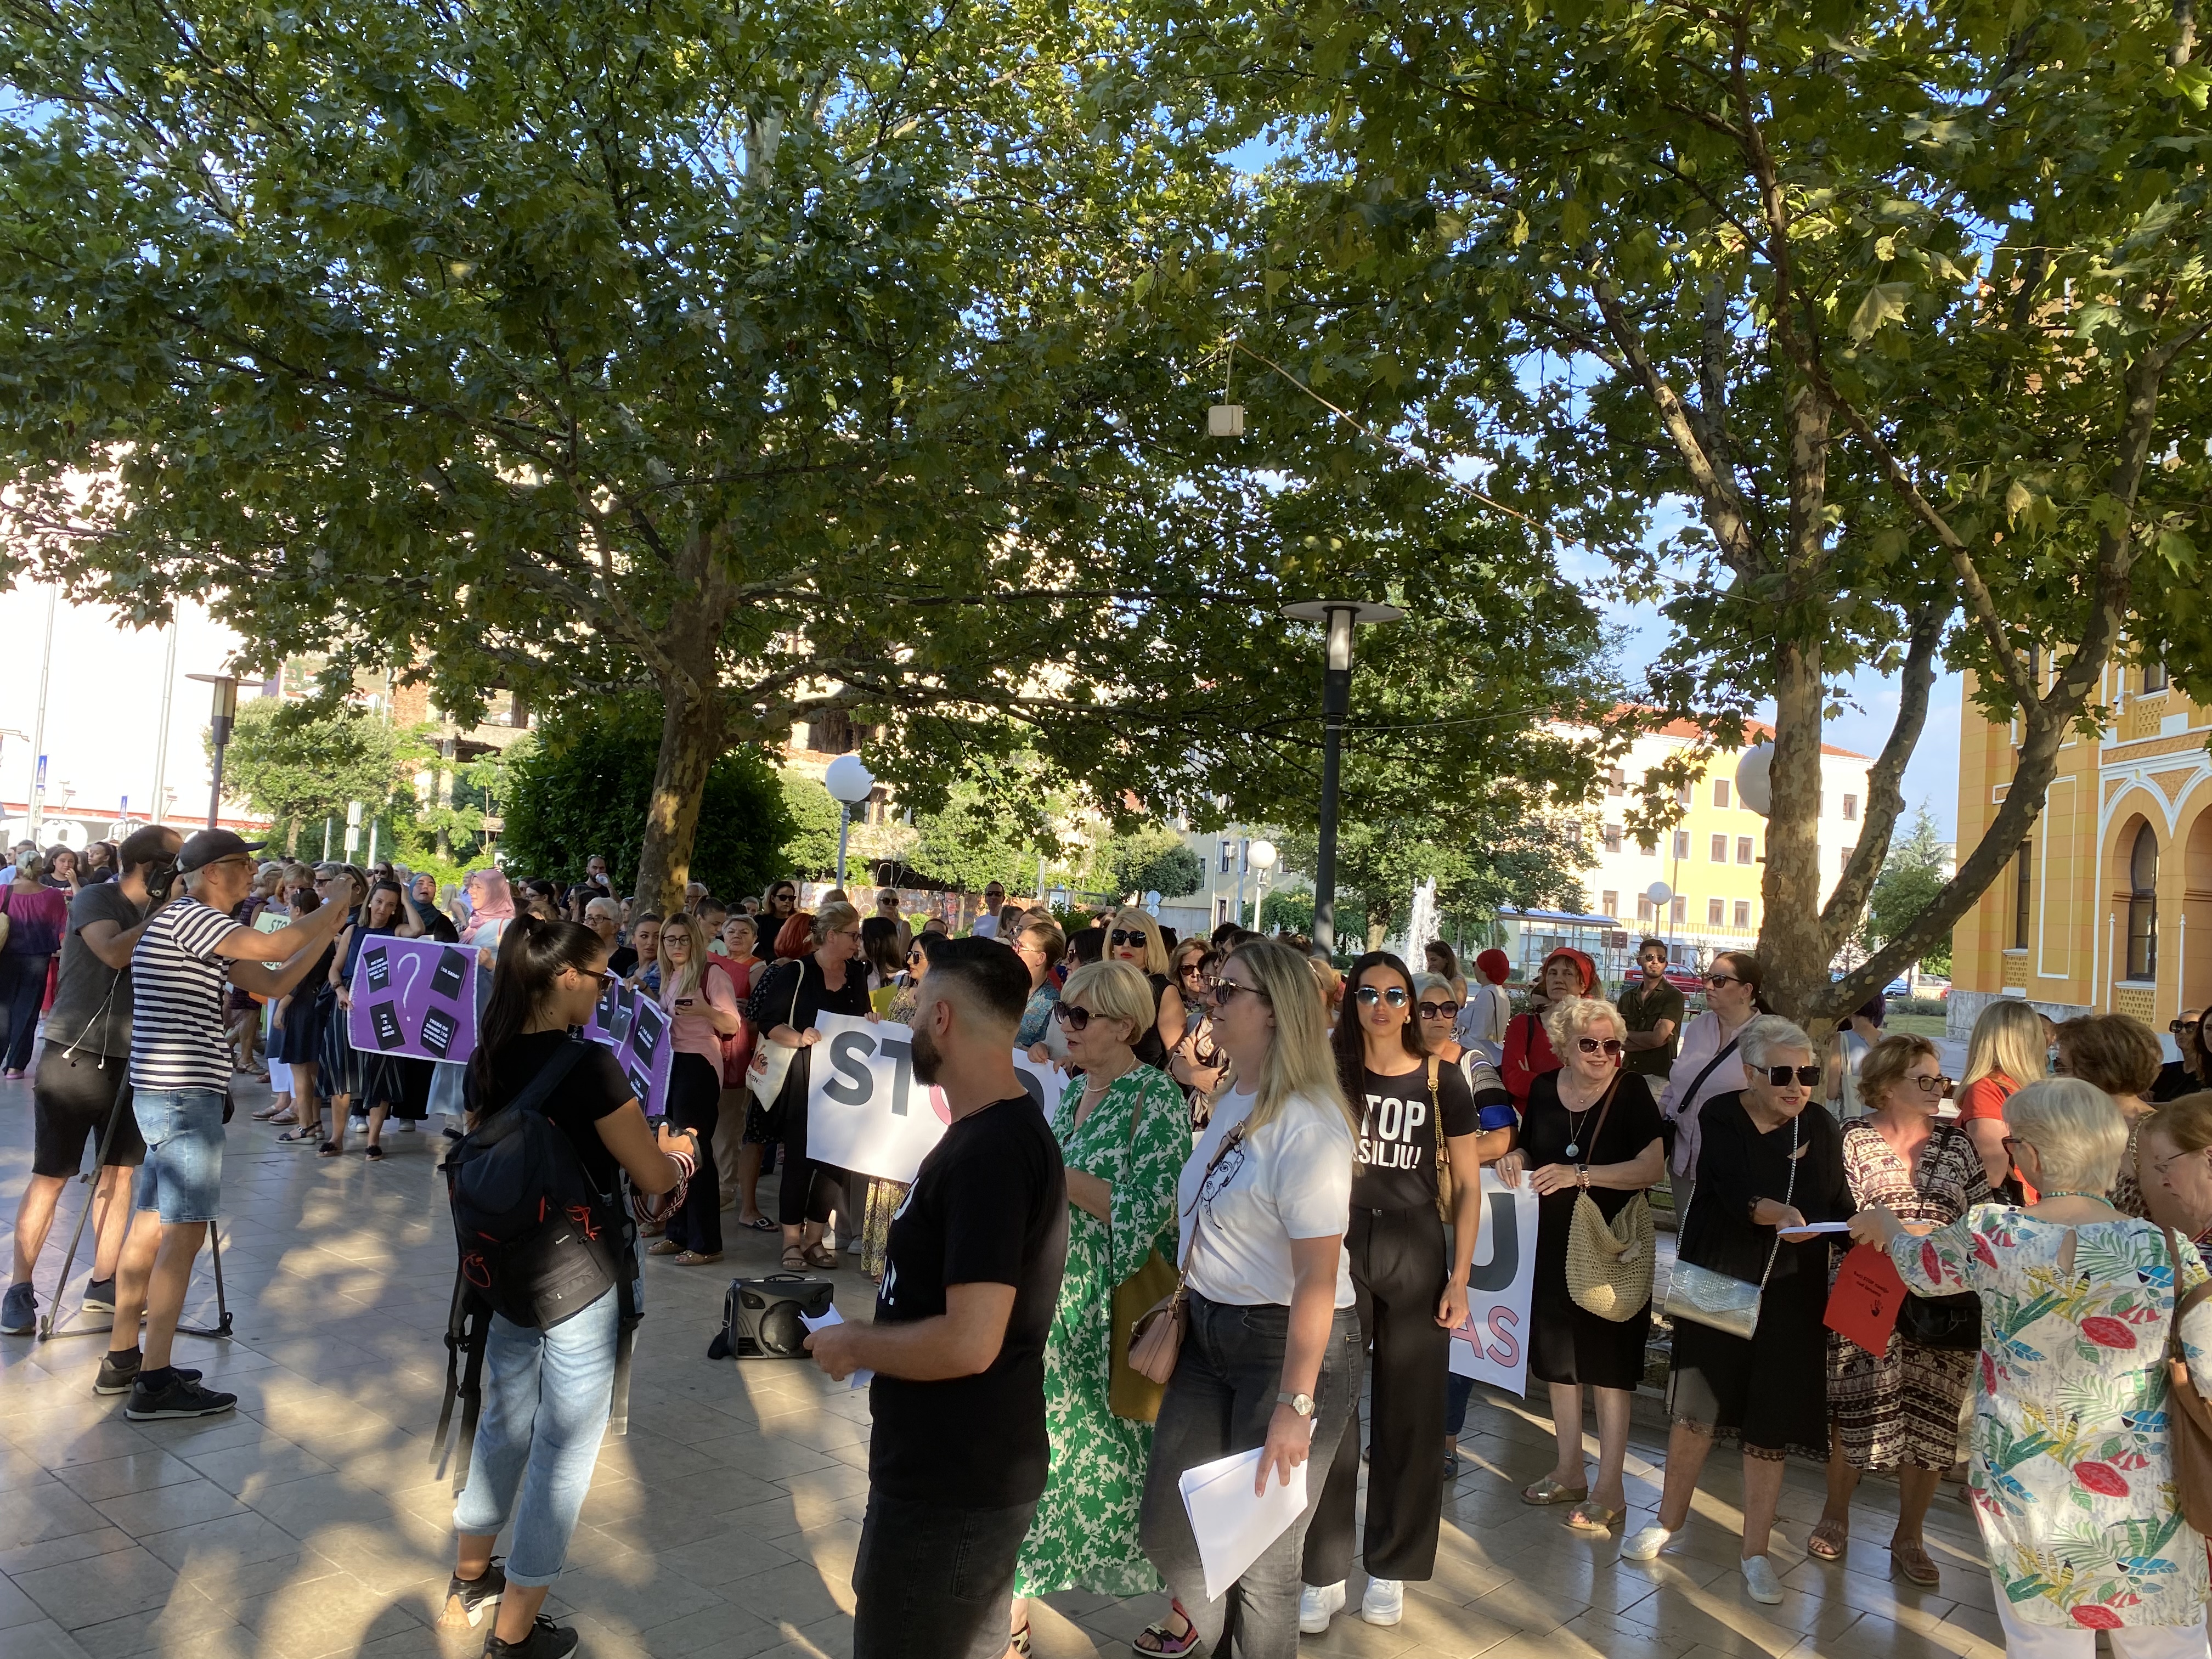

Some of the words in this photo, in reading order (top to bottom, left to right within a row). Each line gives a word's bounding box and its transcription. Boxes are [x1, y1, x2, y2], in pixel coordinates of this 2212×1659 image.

[268, 919, 291, 933] STO
[1361, 1093, 1426, 1143] TOP
[1353, 1138, 1421, 1170] SILJU!
[1449, 1305, 1520, 1368] AS
